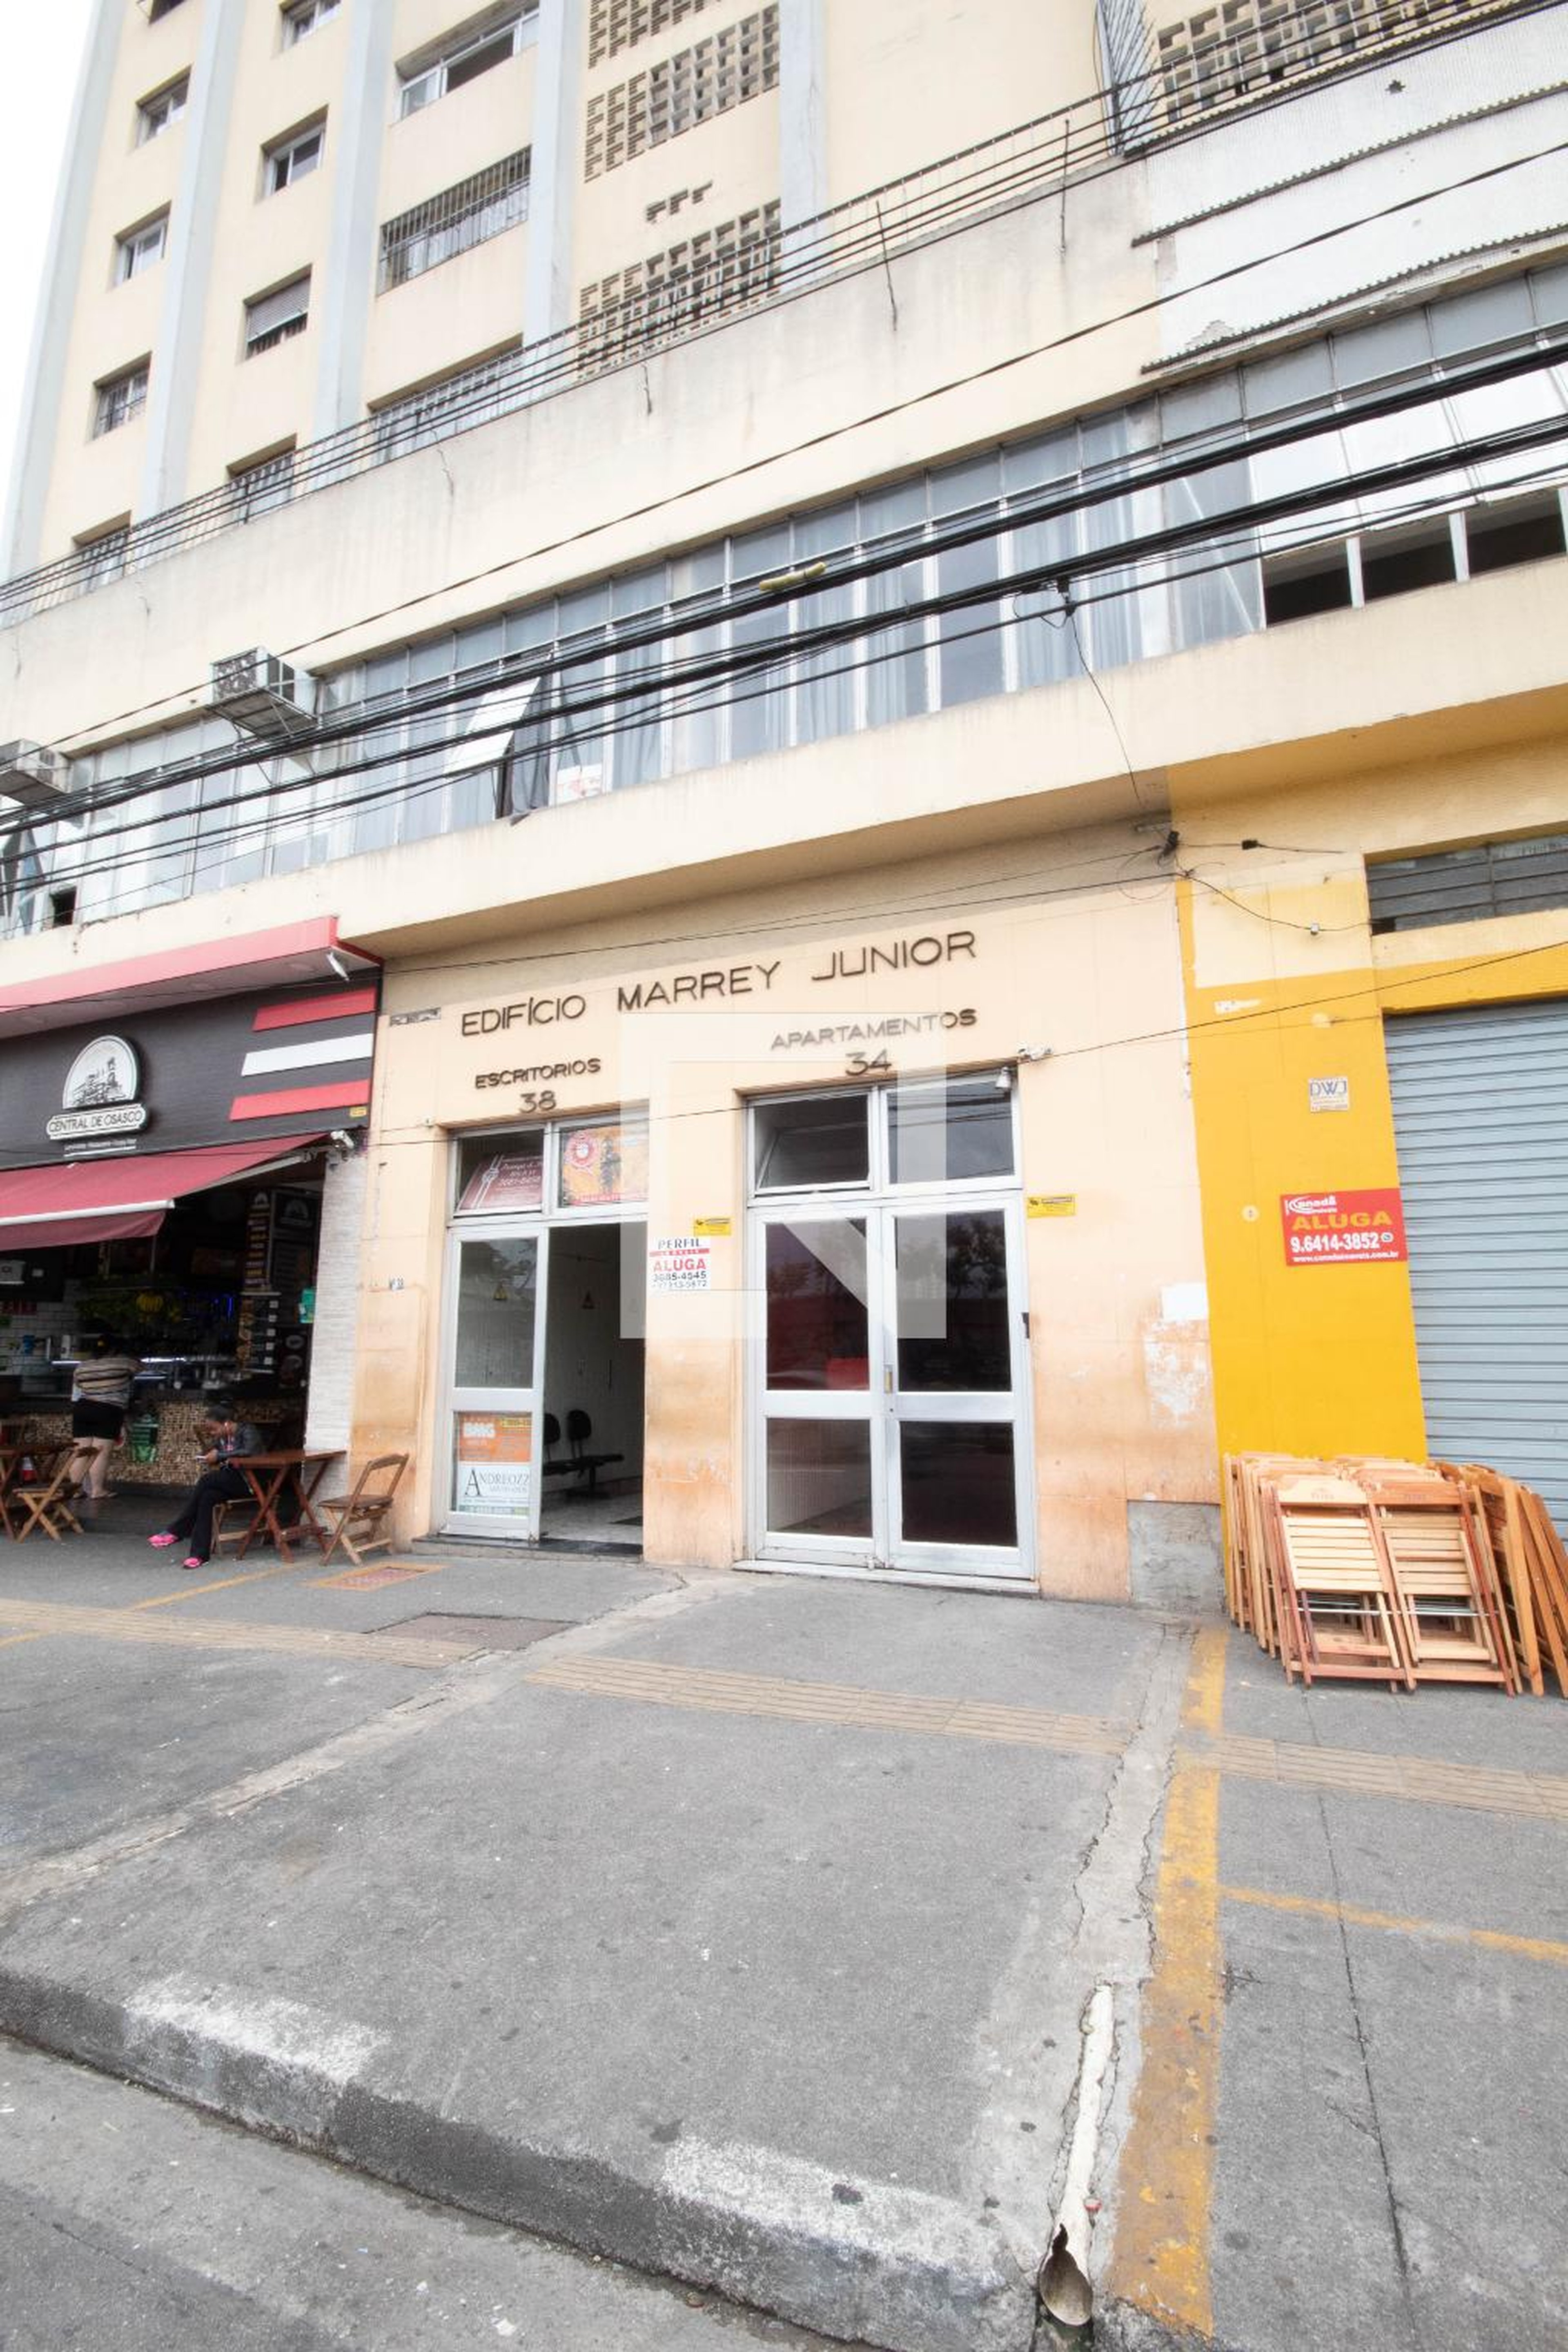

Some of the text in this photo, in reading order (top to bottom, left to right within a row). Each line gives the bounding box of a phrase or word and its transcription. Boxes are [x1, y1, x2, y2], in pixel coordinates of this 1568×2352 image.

[461, 931, 976, 1036] EDIFÍCIO MARREY JUNIOR
[771, 1009, 976, 1050] APARTAMENTOS
[475, 1058, 601, 1089] ESCRITORIOS
[846, 1049, 892, 1076] 34
[519, 1090, 556, 1114] 38
[49, 1110, 142, 1132] CENTRAL DE OSASCO
[1292, 1210, 1392, 1231] ALUGA
[658, 1238, 701, 1250] PERFIL
[654, 1258, 706, 1272] ALUGA
